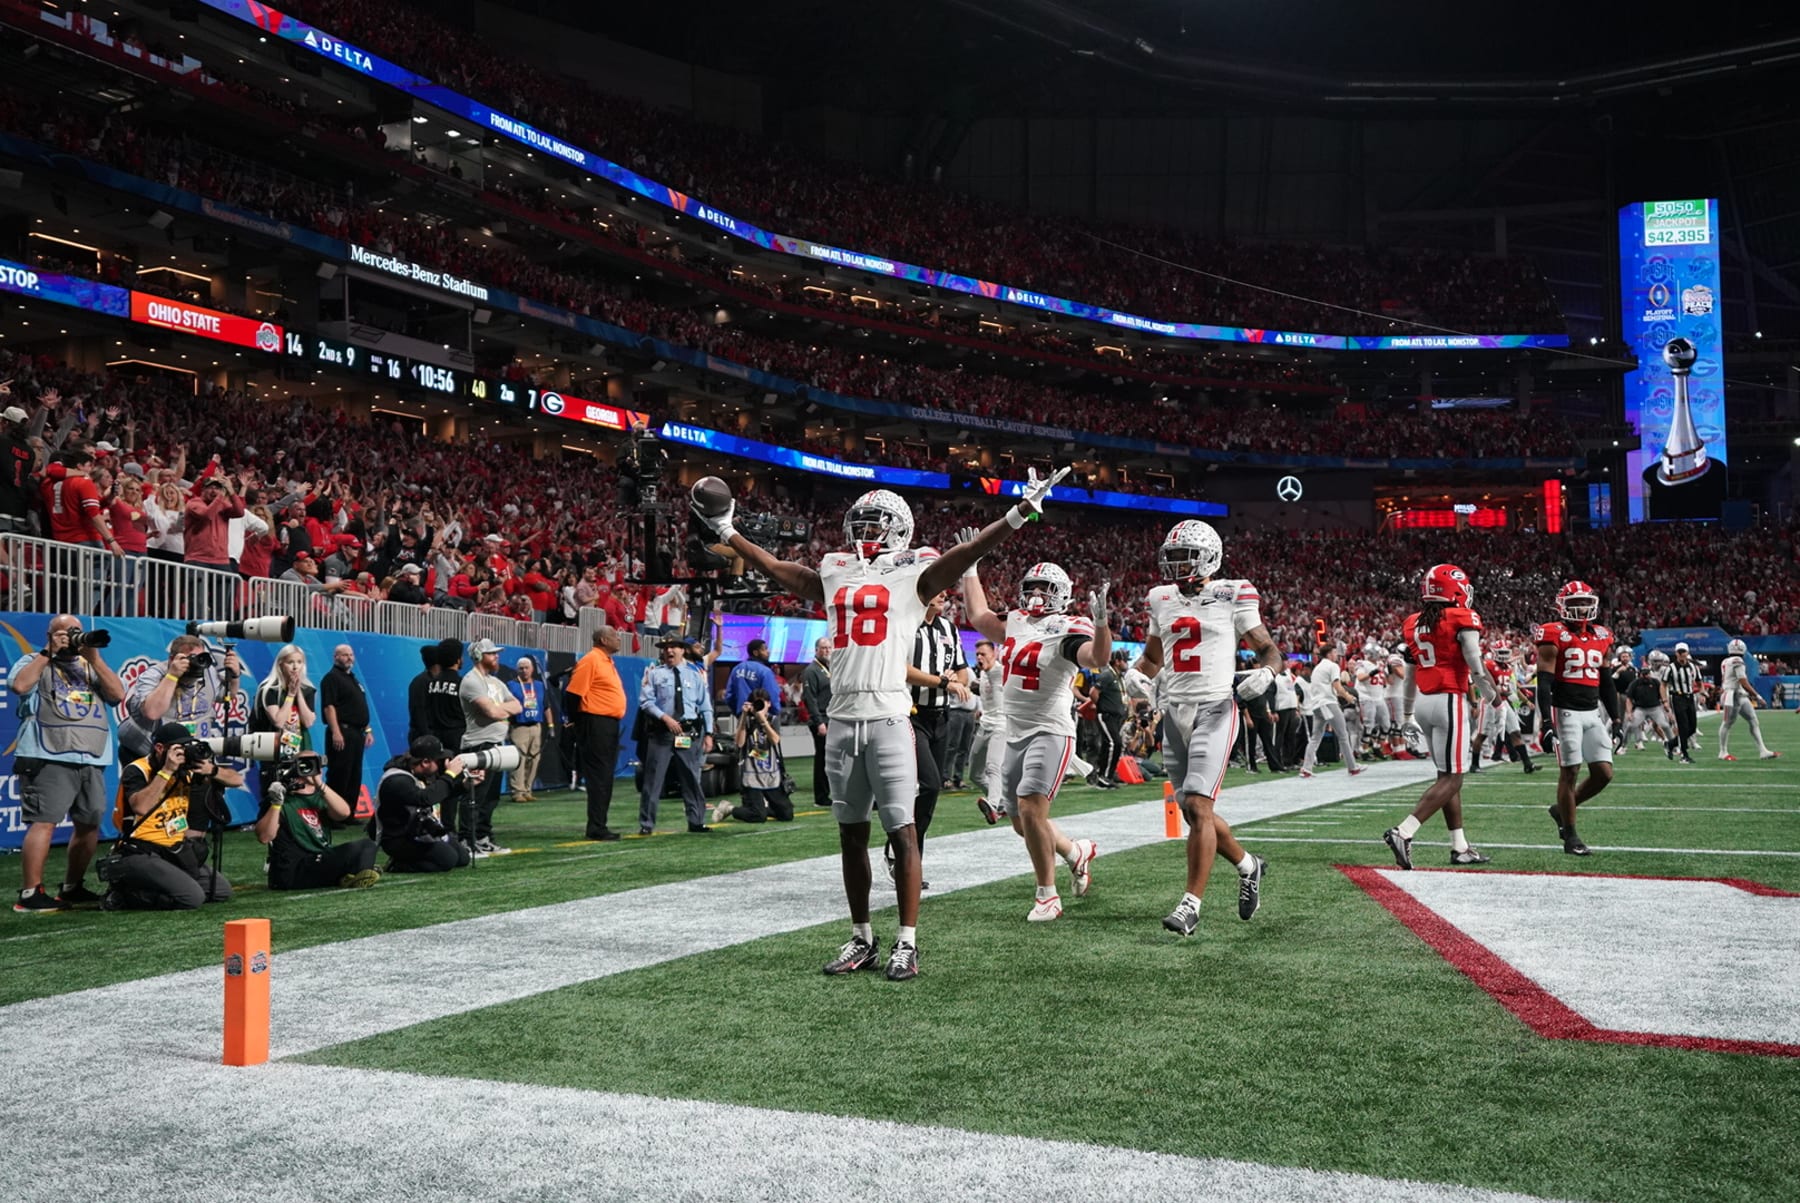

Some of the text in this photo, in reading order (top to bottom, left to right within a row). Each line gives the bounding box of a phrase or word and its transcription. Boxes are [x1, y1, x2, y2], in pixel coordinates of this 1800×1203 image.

[322, 36, 373, 71] DELTA
[490, 112, 586, 165] FROM ATL TO LAX, NONSTOP.
[707, 212, 736, 230] DELTA
[1654, 218, 1696, 226] JACKPOT
[1648, 230, 1705, 243] $42,395
[810, 246, 896, 272] FROM ATL TO LAX, NONSTOP.
[350, 244, 488, 301] Mercedes-Benz Stadium
[1016, 292, 1046, 306] DELTA
[148, 302, 220, 333] OHIO STATE
[286, 332, 302, 356] 14
[1285, 336, 1316, 344] DELTA
[1392, 338, 1410, 346] FROM
[1411, 338, 1422, 346] ATL
[1423, 338, 1432, 346] TO
[319, 341, 355, 366] 2ND & 9
[387, 358, 400, 378] 16
[419, 364, 455, 393] 10:56
[472, 379, 486, 398] 40
[528, 390, 536, 409] 7
[586, 406, 618, 424] GEORGIA
[912, 407, 1075, 440] COLLEGE FOOTBALL PLAYOFF SEMIFINAL
[674, 428, 707, 443] DELTA
[53, 481, 63, 514] 1
[832, 584, 890, 648] 18
[1471, 612, 1480, 626] 5
[1171, 616, 1201, 672] 2
[1414, 626, 1436, 668] 5
[1562, 648, 1602, 678] 29
